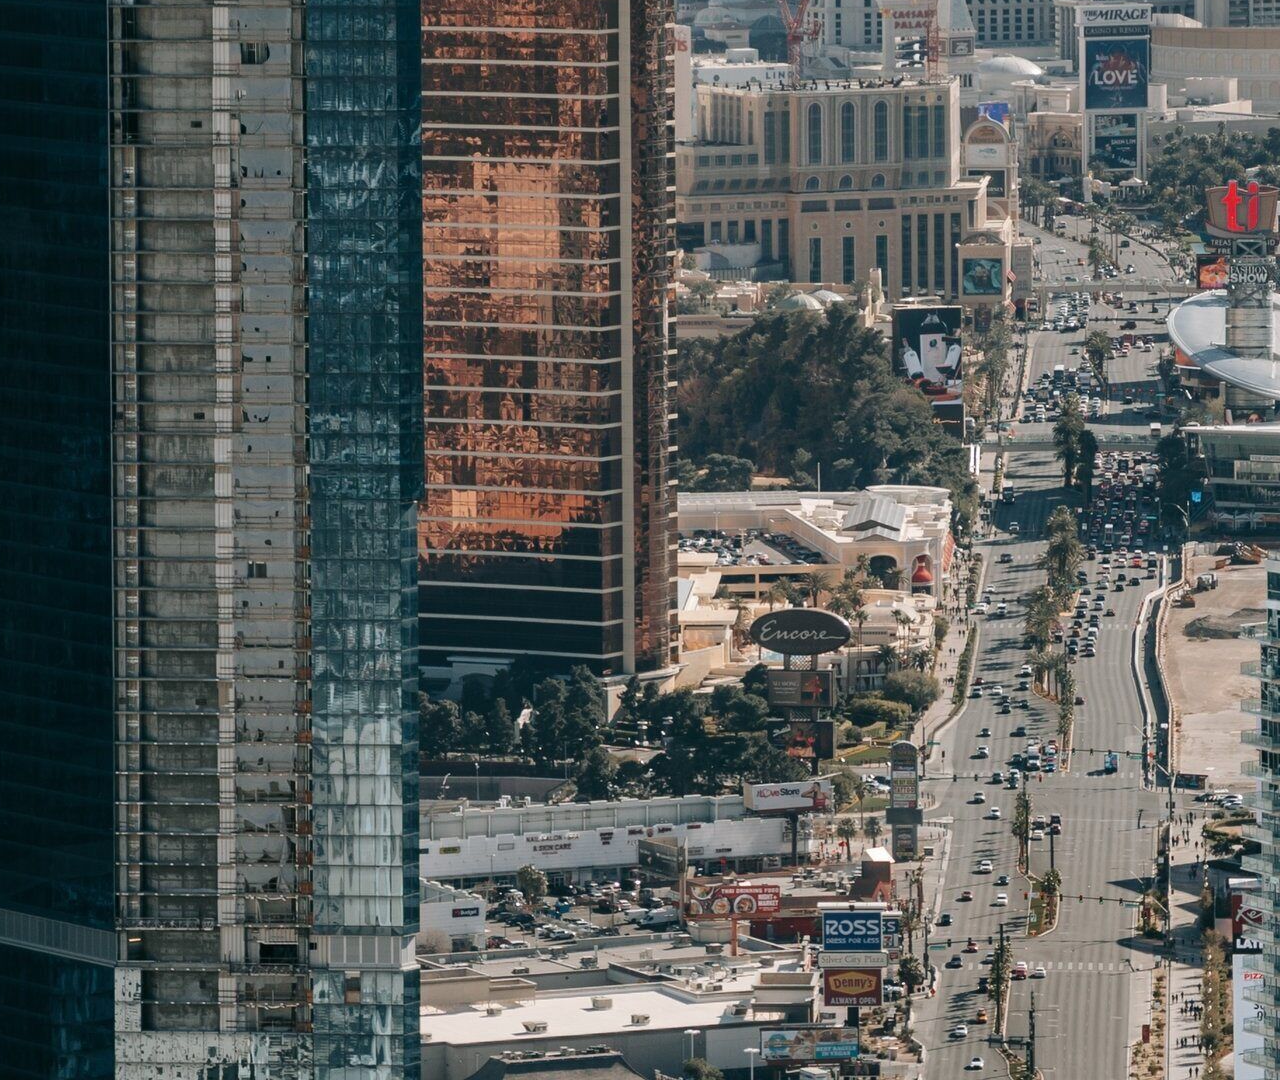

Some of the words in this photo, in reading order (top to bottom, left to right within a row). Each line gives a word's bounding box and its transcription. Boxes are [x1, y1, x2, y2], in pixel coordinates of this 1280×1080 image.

[1087, 8, 1148, 21] MIRAGE
[1094, 69, 1138, 85] LOVE
[1230, 265, 1268, 273] FASHION
[1230, 273, 1268, 283] SHOW
[760, 619, 846, 642] Encore
[825, 919, 880, 935] ROSS
[821, 954, 842, 963] Silver
[845, 954, 861, 965] City
[864, 955, 885, 963] Plaza
[833, 977, 873, 989] Denny's
